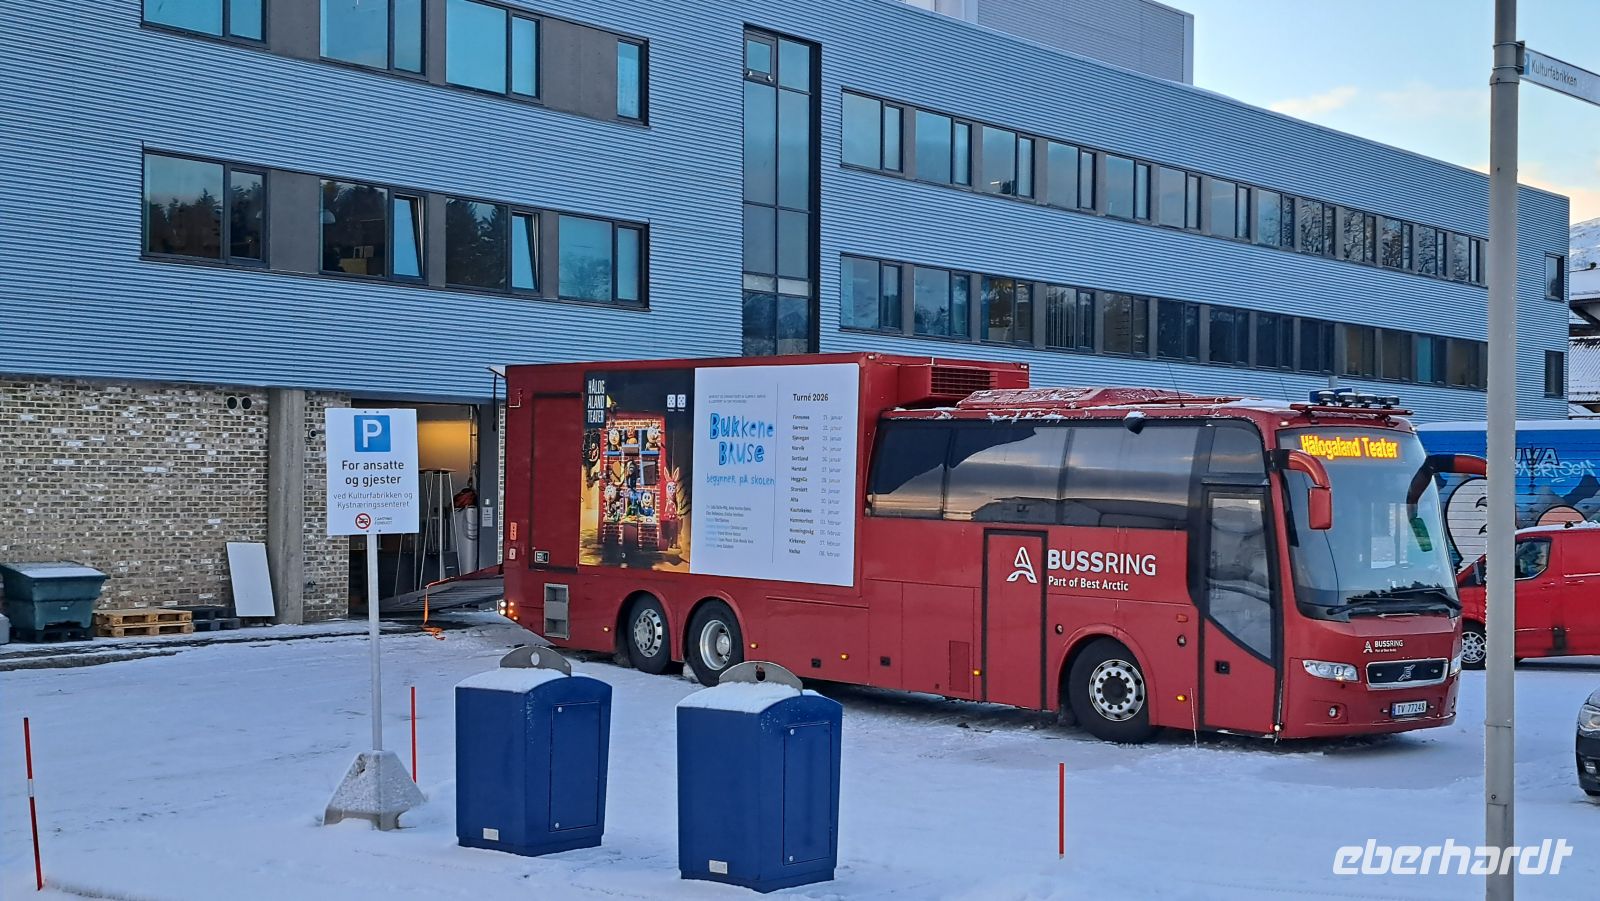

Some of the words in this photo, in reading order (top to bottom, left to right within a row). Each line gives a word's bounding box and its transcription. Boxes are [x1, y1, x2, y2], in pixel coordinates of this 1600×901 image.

[1531, 59, 1577, 86] Kulturfabrikken
[588, 395, 604, 409] ALAND
[793, 392, 812, 402] Turné
[813, 393, 829, 402] 2026
[588, 410, 604, 423] TEATER
[362, 419, 382, 448] P
[1361, 437, 1398, 458] Teater
[342, 460, 360, 470] For
[363, 460, 404, 470] ansatte
[345, 476, 359, 488] og
[362, 474, 402, 488] gjester
[333, 492, 346, 500] ved
[348, 491, 402, 499] Kulturfabrikken
[404, 493, 413, 502] og
[337, 500, 410, 510] Kystnæringssenteret
[1047, 549, 1156, 576] BUSSRING
[1048, 576, 1066, 587] Part
[1069, 577, 1079, 588] of
[1080, 578, 1100, 589] Best
[1102, 580, 1129, 591] Arctic
[1374, 640, 1404, 648] BUSSRING
